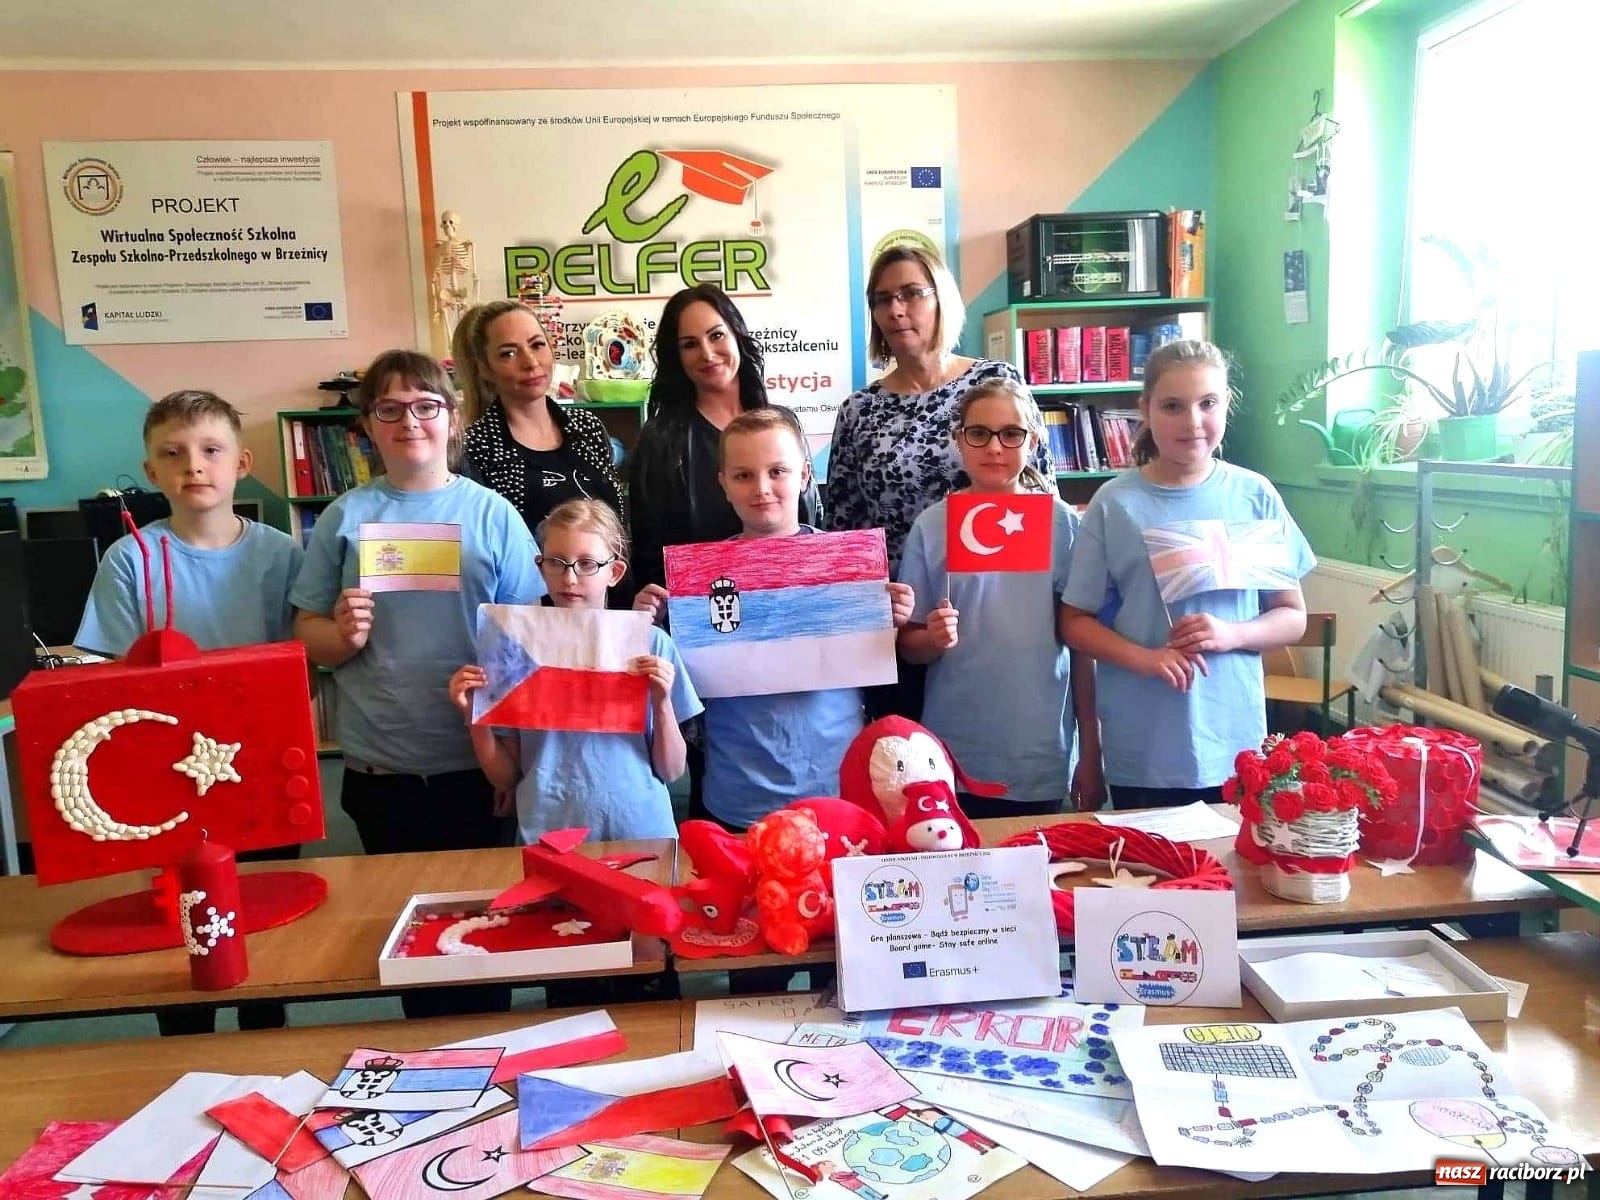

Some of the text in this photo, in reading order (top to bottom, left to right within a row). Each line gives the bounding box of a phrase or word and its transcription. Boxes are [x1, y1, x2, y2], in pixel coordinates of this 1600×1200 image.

[432, 118, 461, 128] Projekt
[463, 118, 535, 128] współfinansowany
[550, 116, 583, 125] środków
[585, 116, 601, 124] Unii
[603, 115, 651, 125] Europejskiej
[662, 114, 691, 123] ramach
[693, 113, 749, 123] Europejskiego
[750, 113, 789, 121] Funduszu
[790, 111, 841, 121] Społecznego
[196, 155, 232, 164] Człowiek
[240, 155, 279, 165] najlepsza
[280, 155, 321, 165] inwestycja
[152, 197, 240, 214] PROJEKT
[582, 150, 689, 243] e
[100, 226, 296, 245] Wirtualna Społeczność Szkolna
[71, 247, 328, 266] Zespołu Szkolno-Przedszkolnego w Brzeźnicy
[503, 240, 771, 299] BELFER
[748, 327, 798, 341] zeźnicy
[1109, 333, 1121, 378] MACHINES
[766, 371, 832, 393] stycja
[1000, 925, 1017, 933] sieci
[977, 937, 998, 946] online
[1116, 932, 1199, 965] STEAM
[929, 966, 979, 978] Erasmus+
[887, 1007, 1084, 1052] ERROR
